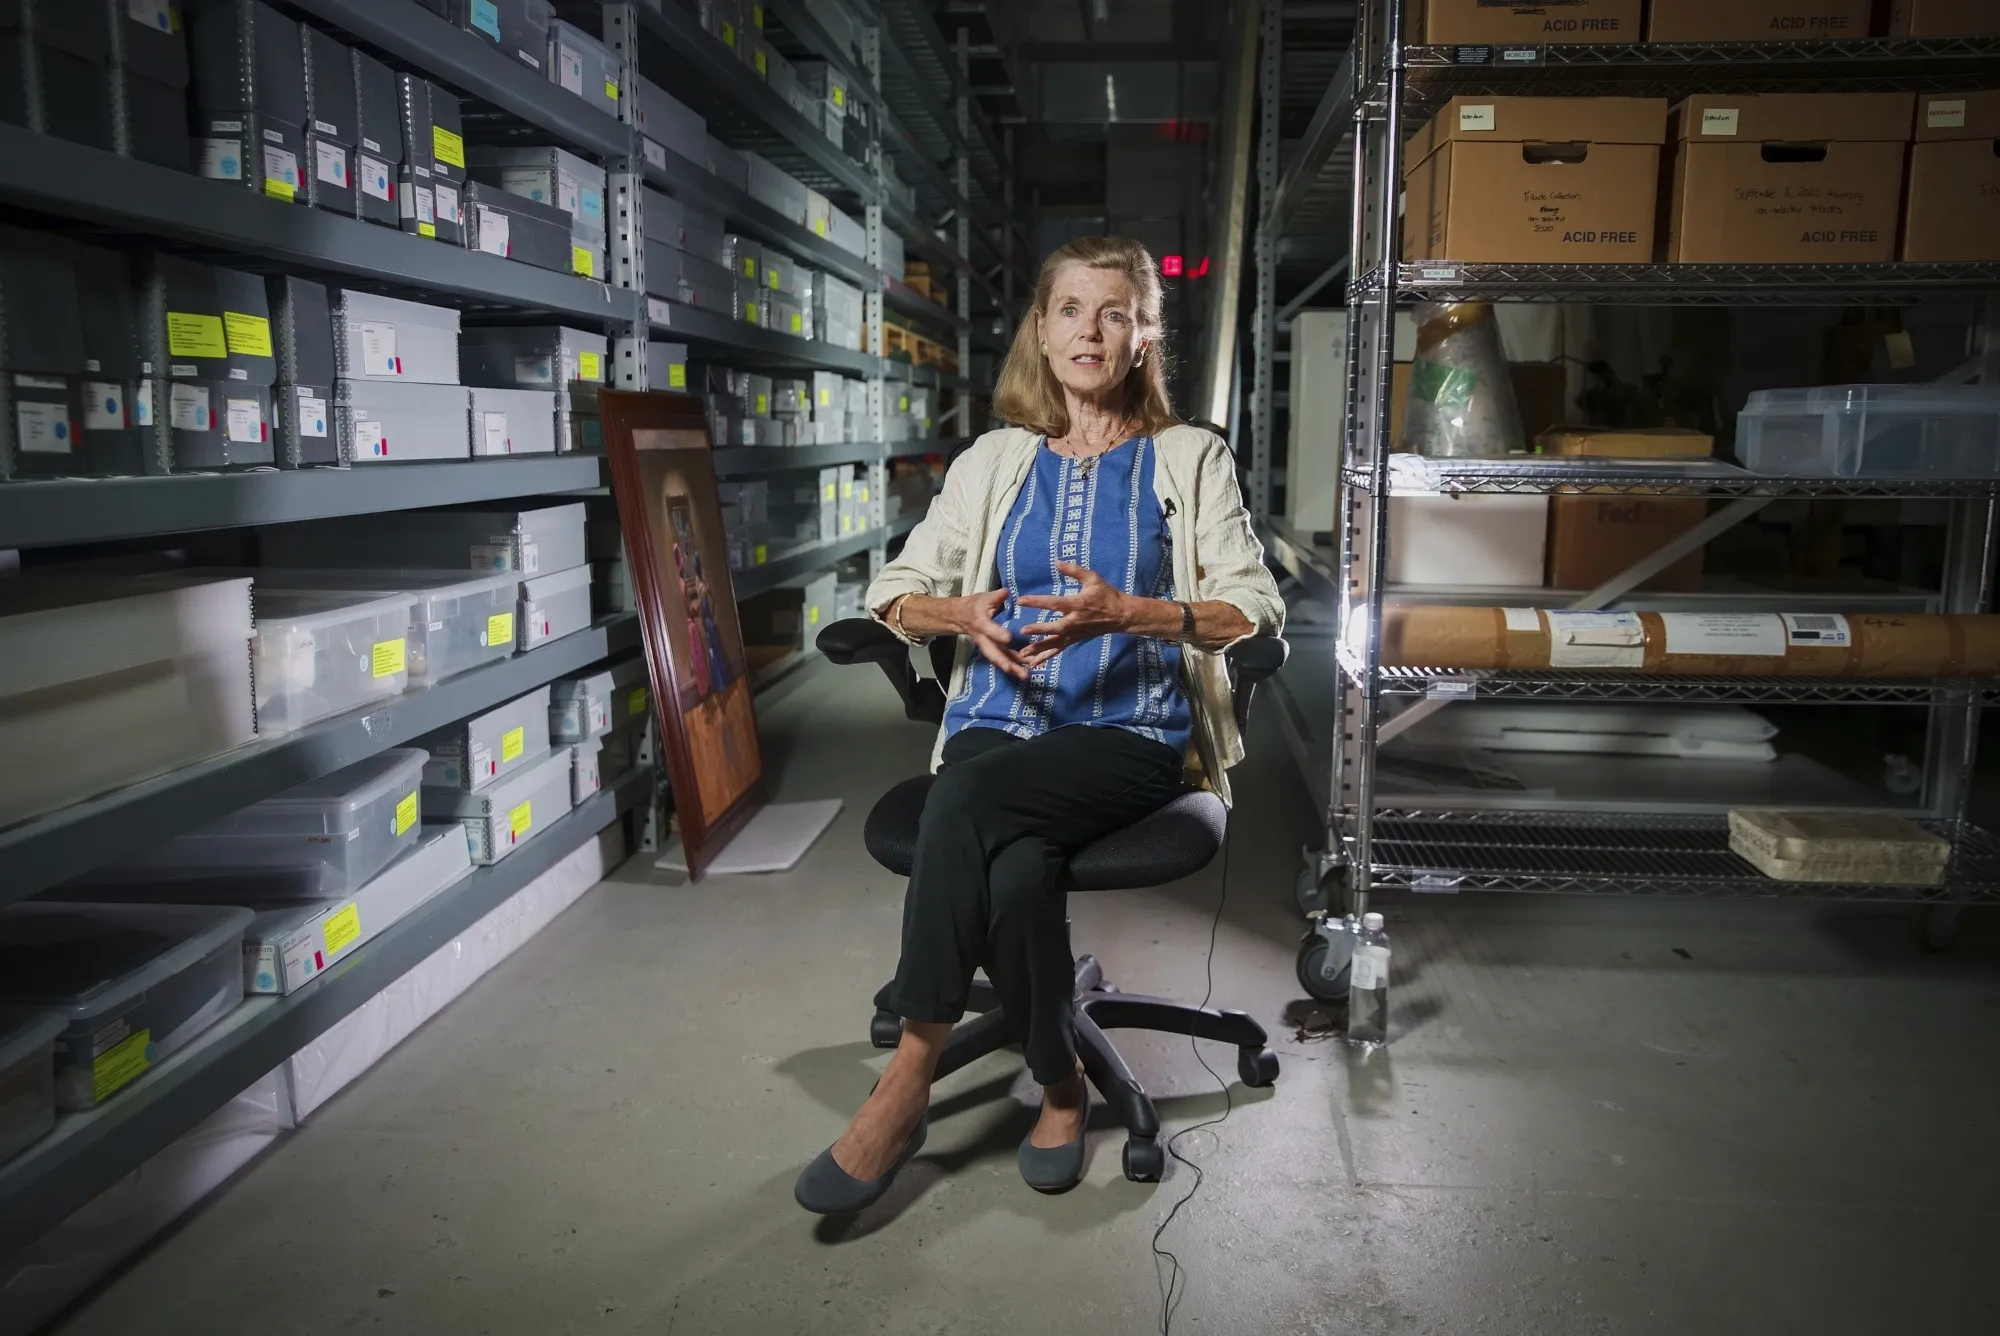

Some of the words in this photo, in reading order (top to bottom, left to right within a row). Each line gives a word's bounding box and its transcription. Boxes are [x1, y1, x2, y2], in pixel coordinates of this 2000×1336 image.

[1543, 19, 1577, 31] ACID
[1582, 18, 1619, 30] FREE
[1769, 17, 1805, 29] ACID
[1810, 16, 1849, 29] FREE
[1523, 190, 1547, 202] Tribute
[1550, 190, 1581, 201] Collection
[1735, 188, 1776, 201] September
[1798, 186, 1821, 198] 2020
[1534, 224, 1553, 232] 2020
[1563, 231, 1596, 243] ACID
[1600, 231, 1637, 243] FREE
[1801, 231, 1836, 243] ACID
[1840, 231, 1878, 243] FREE
